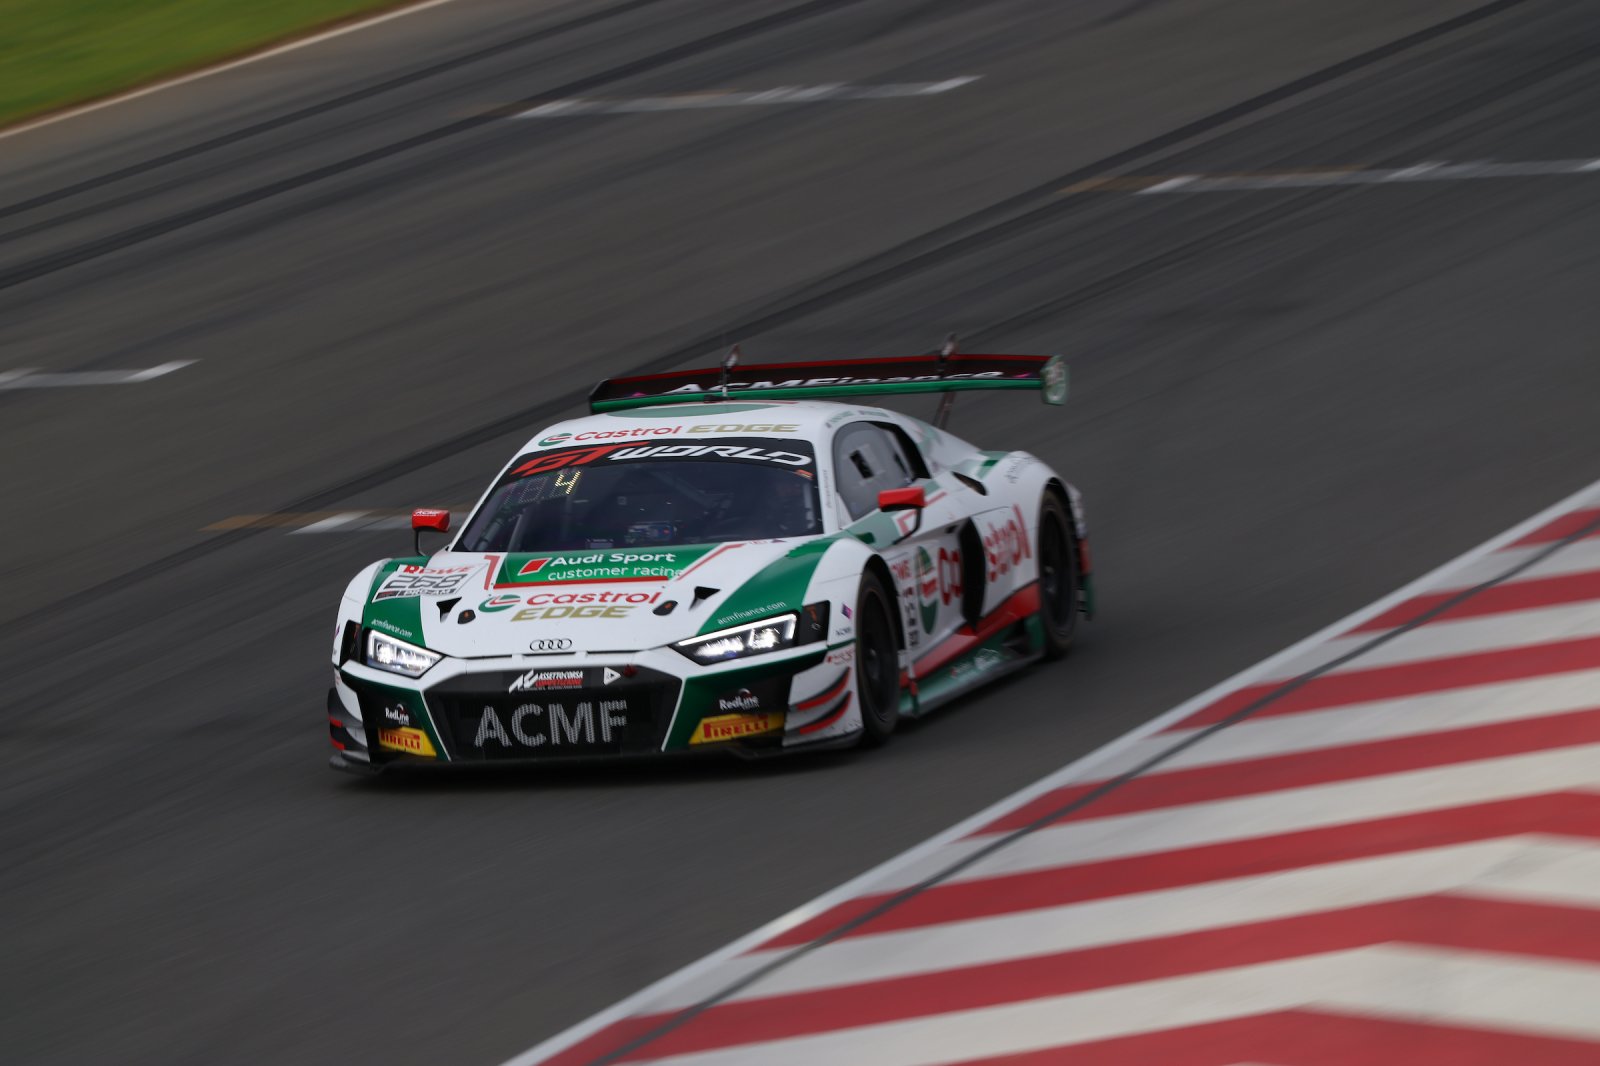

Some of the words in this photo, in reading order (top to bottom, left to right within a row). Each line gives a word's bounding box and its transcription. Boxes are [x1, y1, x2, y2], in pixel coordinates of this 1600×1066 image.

[573, 425, 682, 441] Castrol
[686, 424, 801, 434] EDGE
[550, 554, 604, 567] Audi
[609, 553, 677, 565] Sport
[548, 567, 629, 581] customer
[526, 591, 663, 605] Castrol
[510, 605, 638, 622] EDGE
[717, 601, 787, 625] acmfinance.com
[474, 700, 627, 748] ACMF
[703, 714, 769, 739] PIRELLI
[381, 729, 421, 752] PIRELLI
